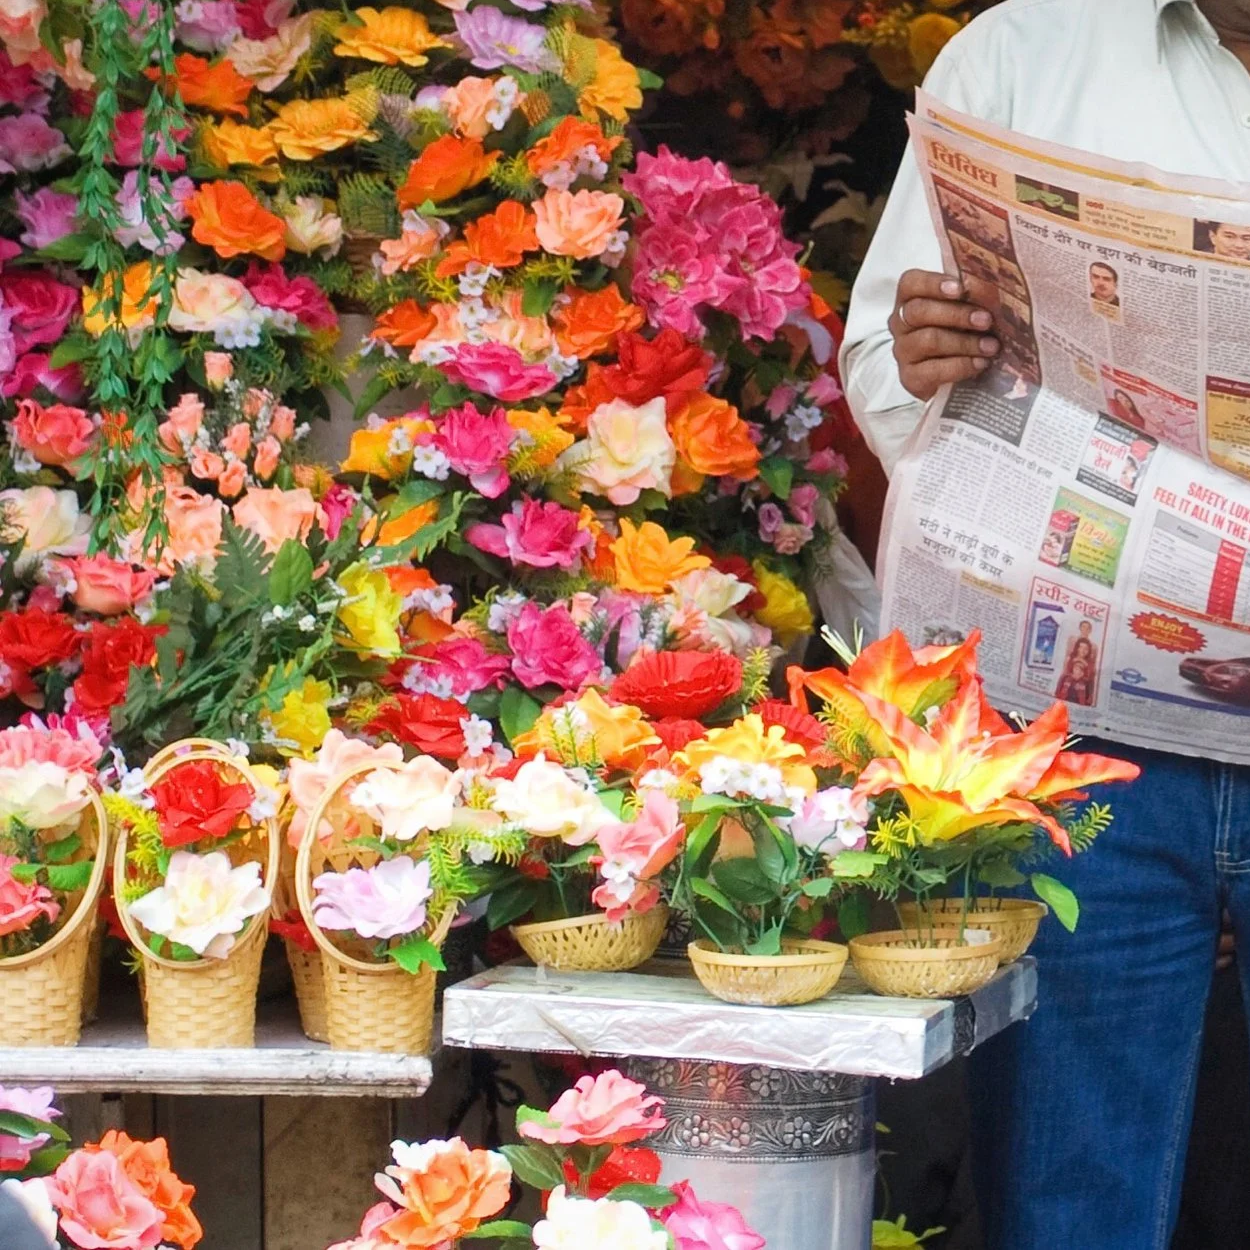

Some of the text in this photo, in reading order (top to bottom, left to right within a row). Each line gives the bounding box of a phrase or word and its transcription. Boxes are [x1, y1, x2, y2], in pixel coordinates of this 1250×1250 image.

[930, 141, 998, 188] विविध
[1052, 229, 1073, 247] दौरे
[1076, 239, 1092, 251] पर
[1122, 250, 1142, 267] की
[1153, 486, 1178, 509] FEEL
[1178, 498, 1190, 514] IT
[1190, 503, 1210, 526] ALL
[1211, 512, 1225, 531] IN
[1226, 520, 1249, 542] THE
[1037, 583, 1070, 606] स्पीड
[1150, 617, 1184, 635] ENJOY
